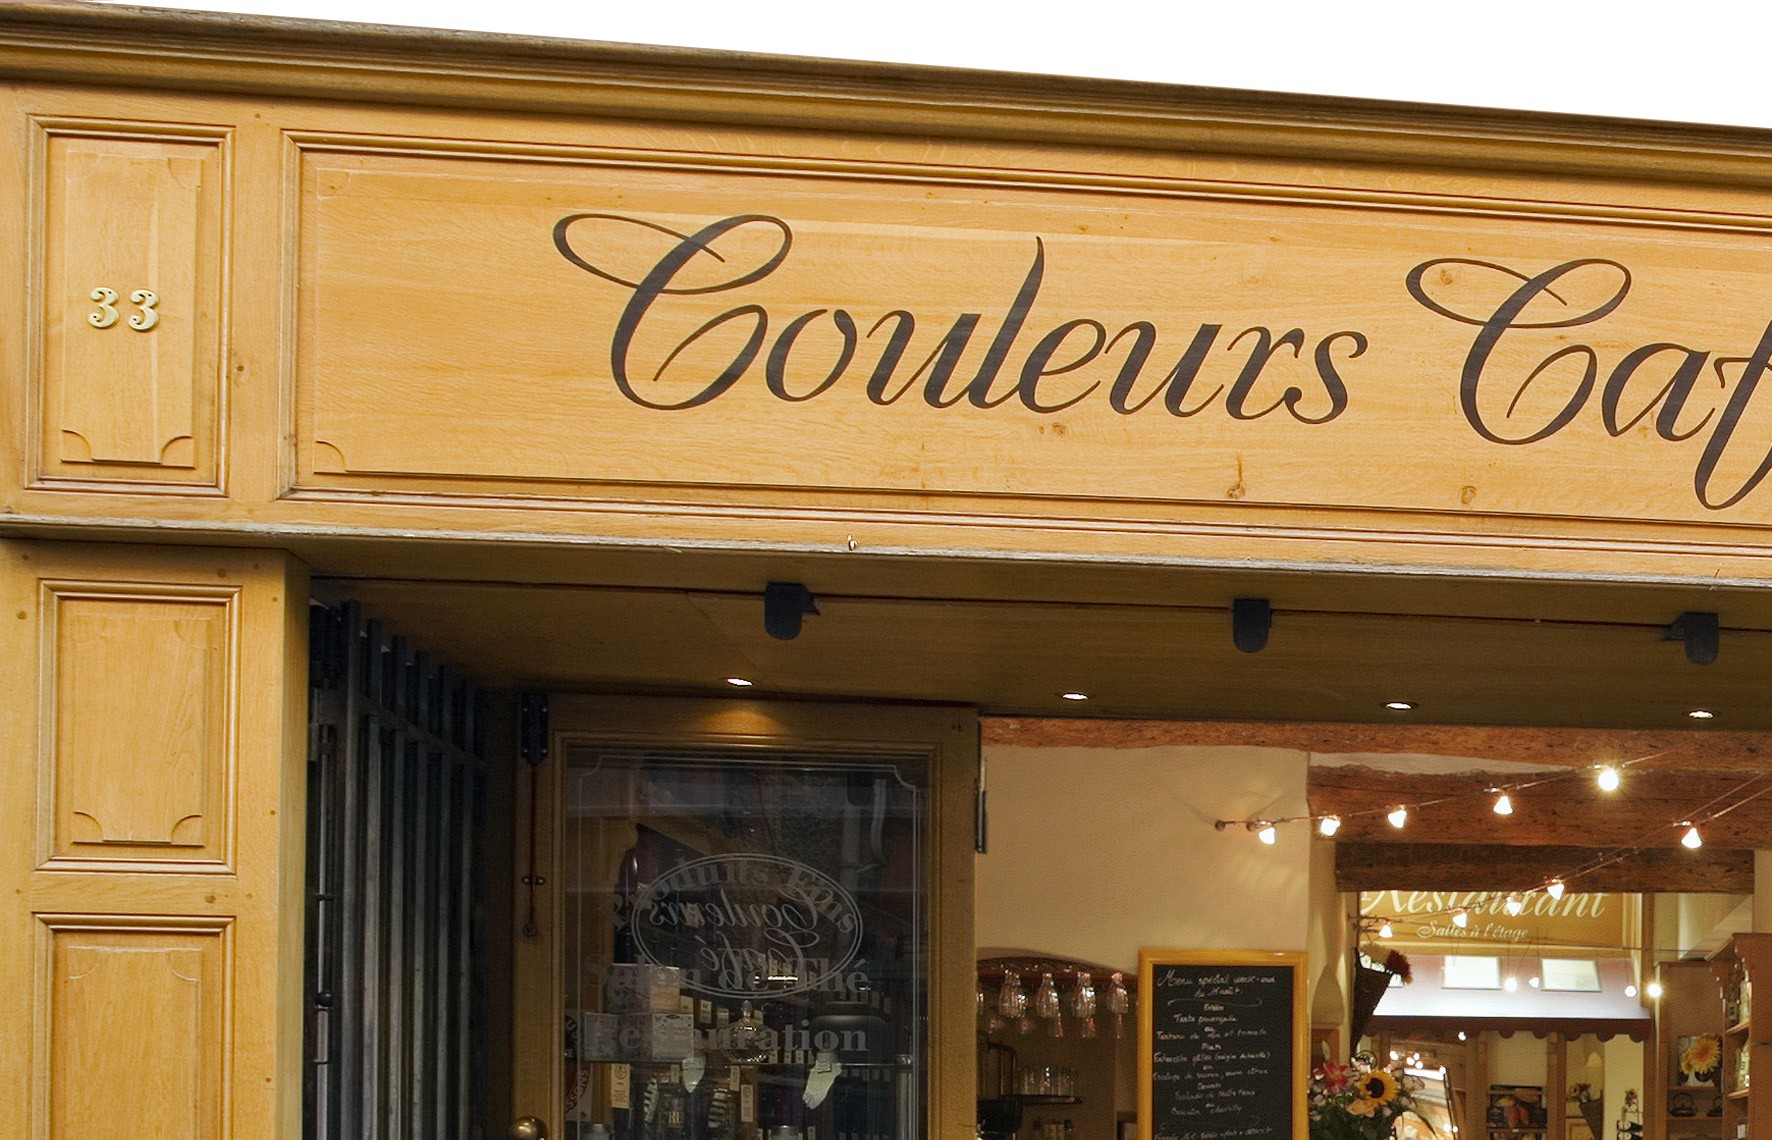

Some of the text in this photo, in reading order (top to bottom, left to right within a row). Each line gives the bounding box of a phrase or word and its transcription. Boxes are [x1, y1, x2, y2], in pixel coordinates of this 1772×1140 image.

[88, 287, 160, 331] 33
[552, 213, 1368, 424] Couleurs
[591, 1019, 868, 1052] Reauration
